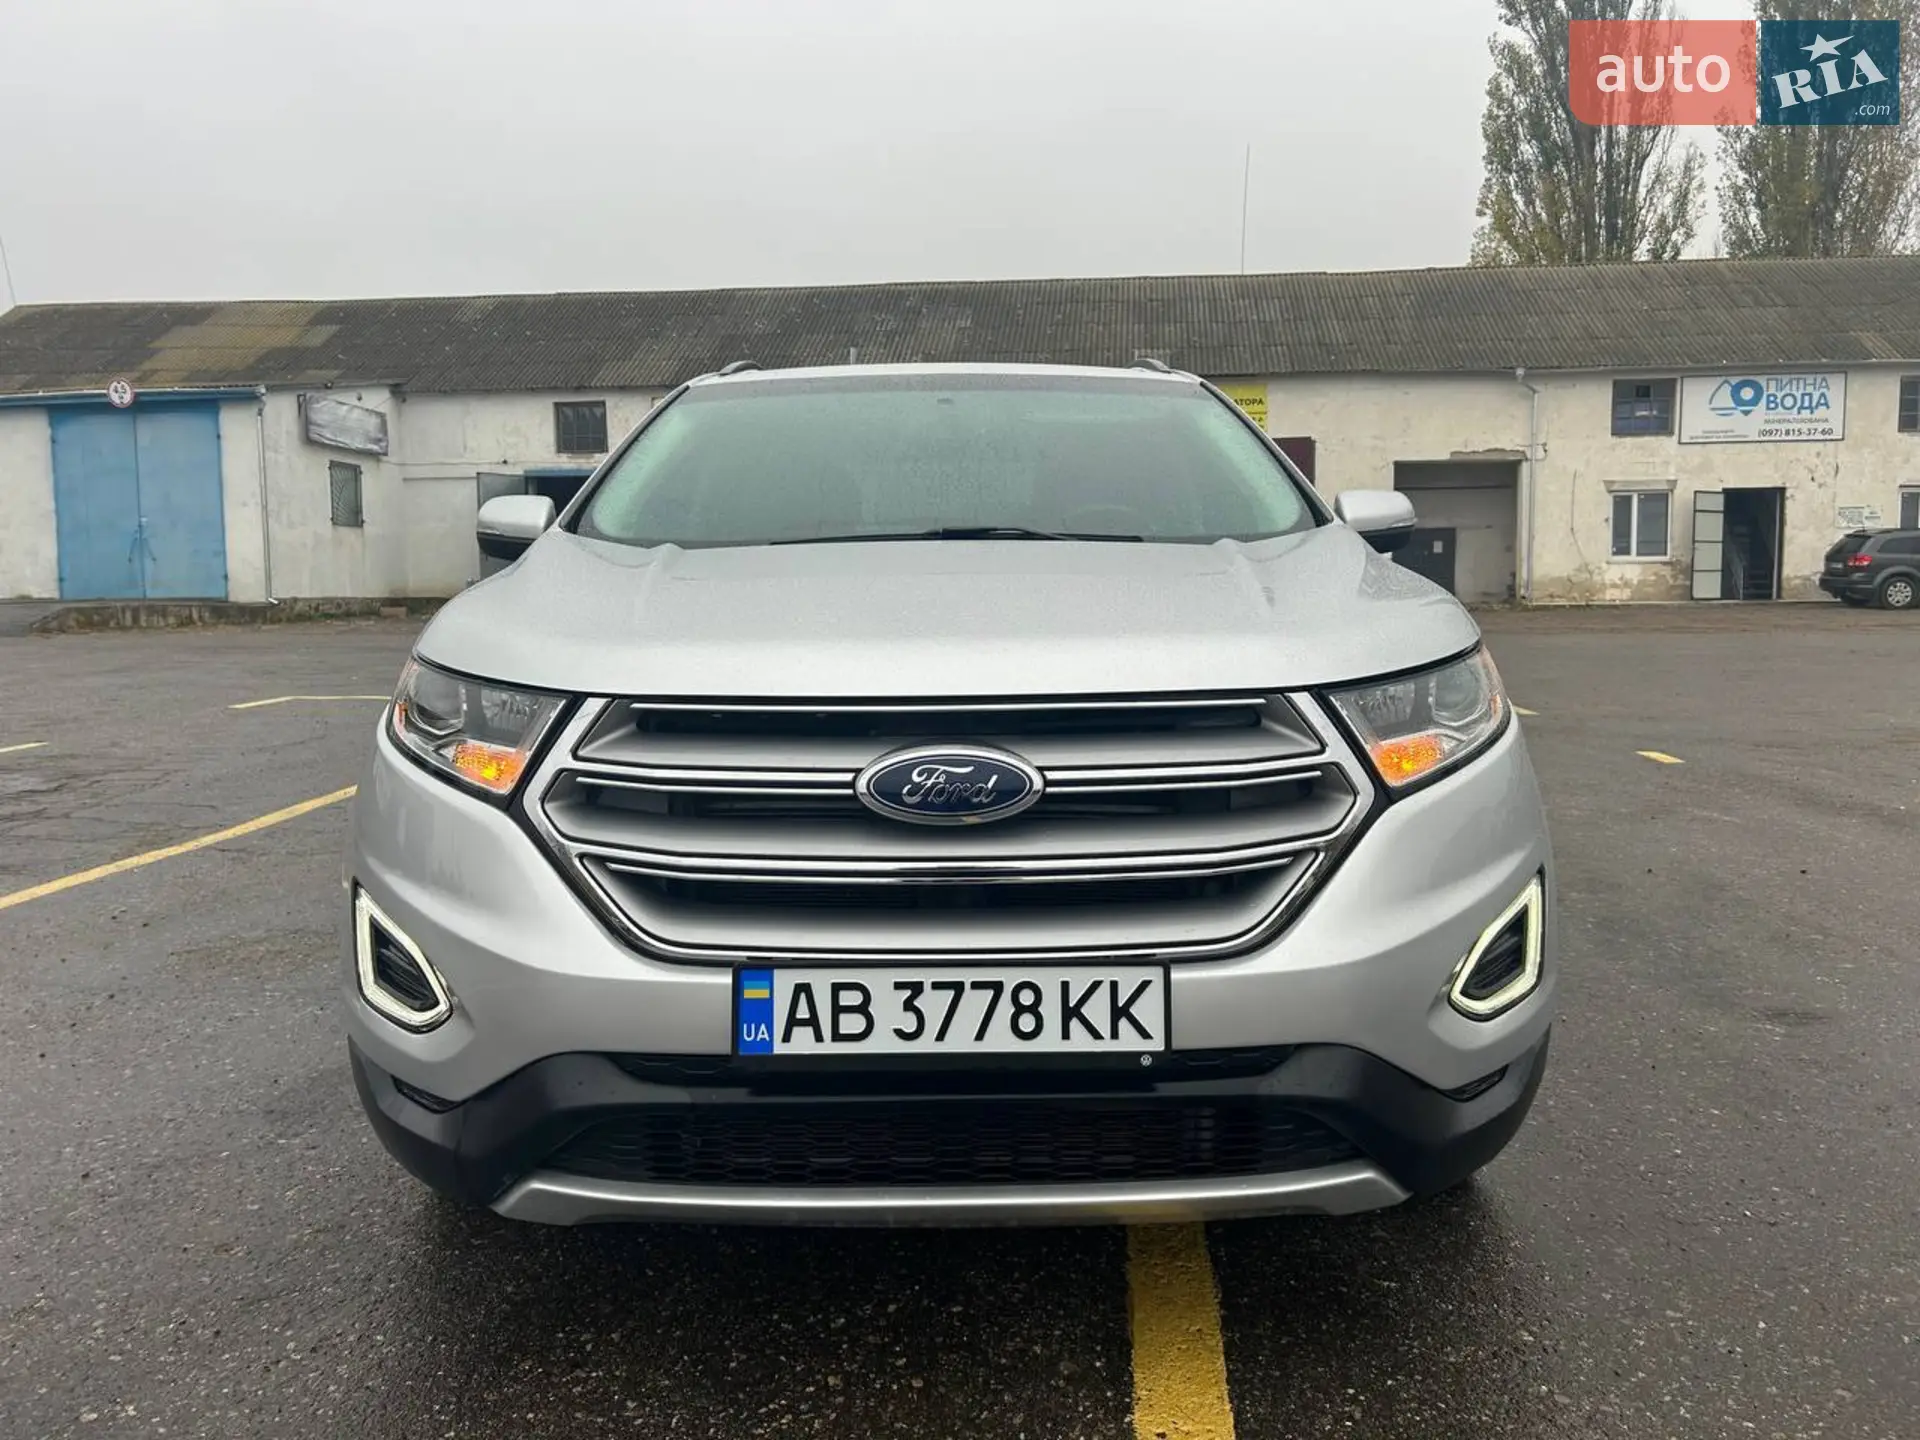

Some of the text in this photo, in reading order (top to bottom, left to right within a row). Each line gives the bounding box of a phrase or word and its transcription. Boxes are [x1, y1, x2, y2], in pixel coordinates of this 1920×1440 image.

[1766, 376, 1830, 392] ПИТНА
[1765, 393, 1830, 415] ВОДА
[1758, 428, 1783, 438] (097)
[1784, 427, 1834, 437] 815-37-60
[901, 764, 998, 805] Ford
[781, 979, 1154, 1044] AB 3778 KK
[742, 1022, 770, 1042] UA
